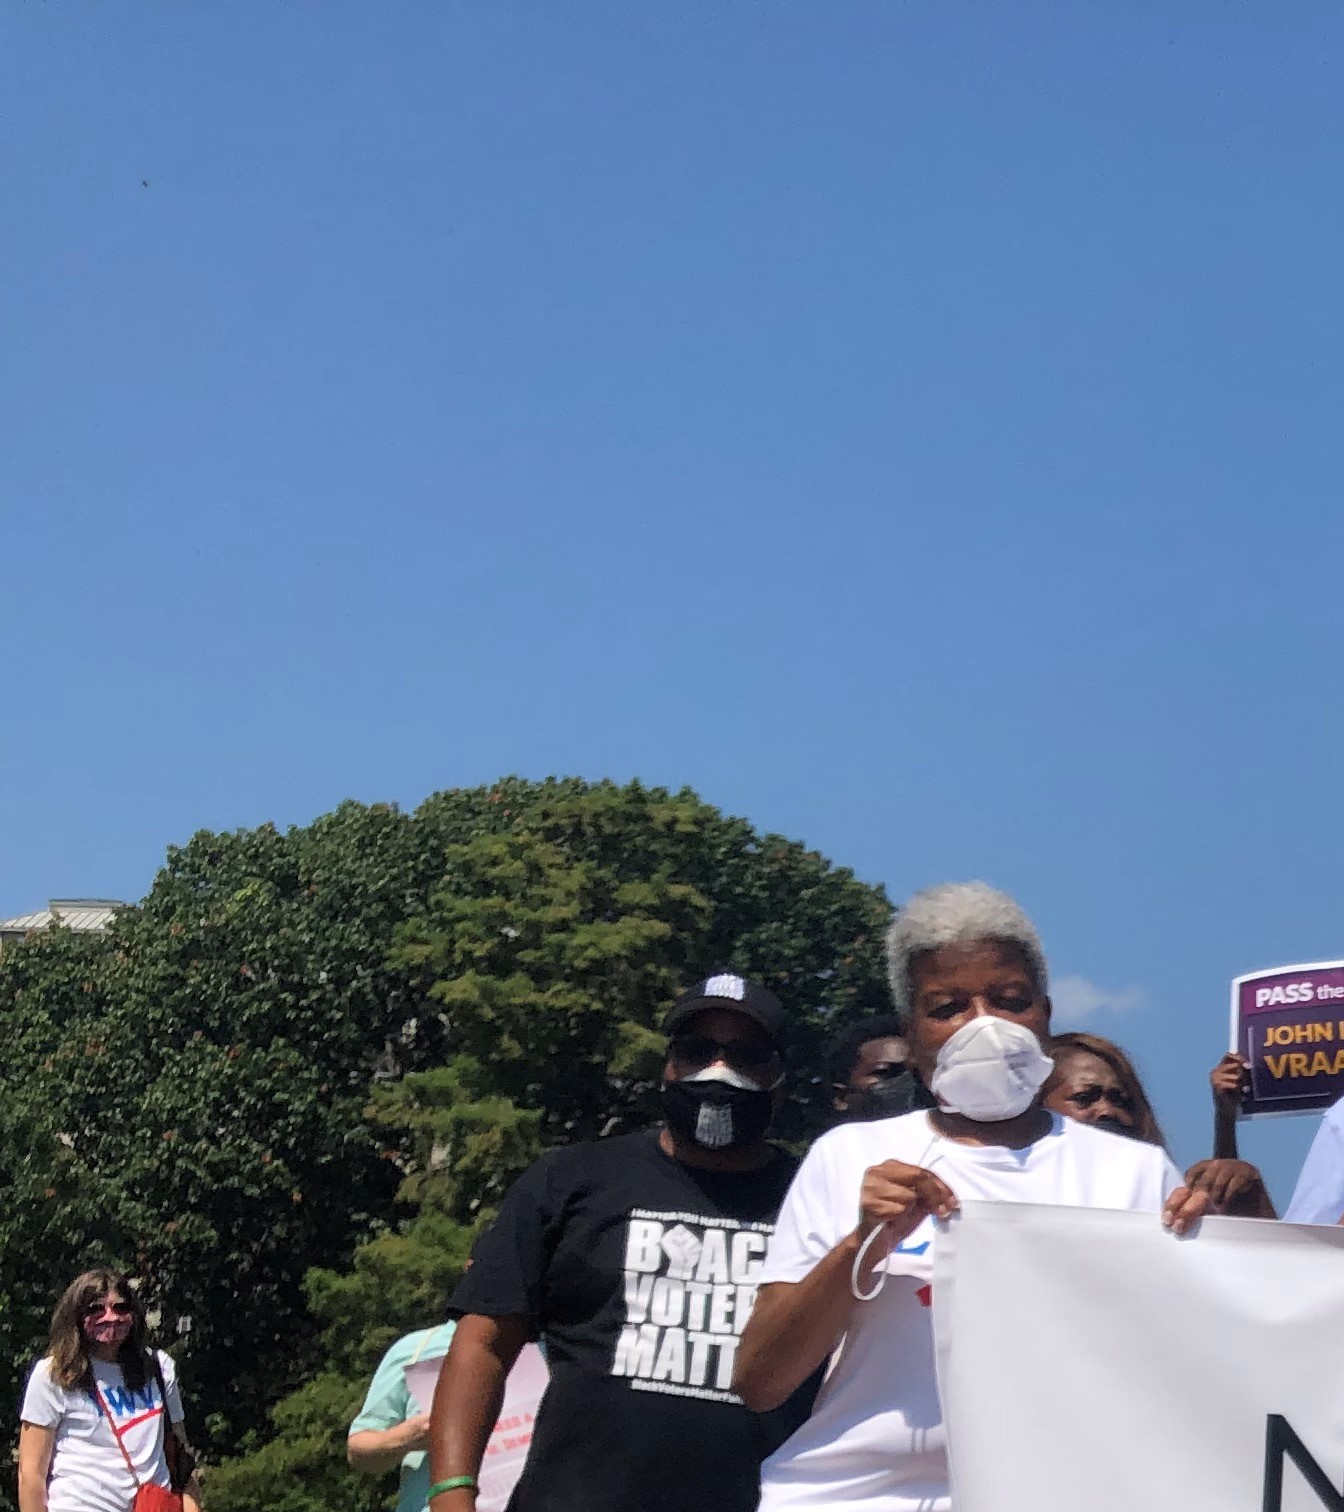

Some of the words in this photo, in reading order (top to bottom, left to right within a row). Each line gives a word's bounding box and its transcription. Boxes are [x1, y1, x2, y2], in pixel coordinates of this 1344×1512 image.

[1256, 982, 1314, 1008] PASS
[1263, 1022, 1335, 1047] JOHN
[624, 1270, 758, 1335] VOTE
[609, 1323, 741, 1391] MATT
